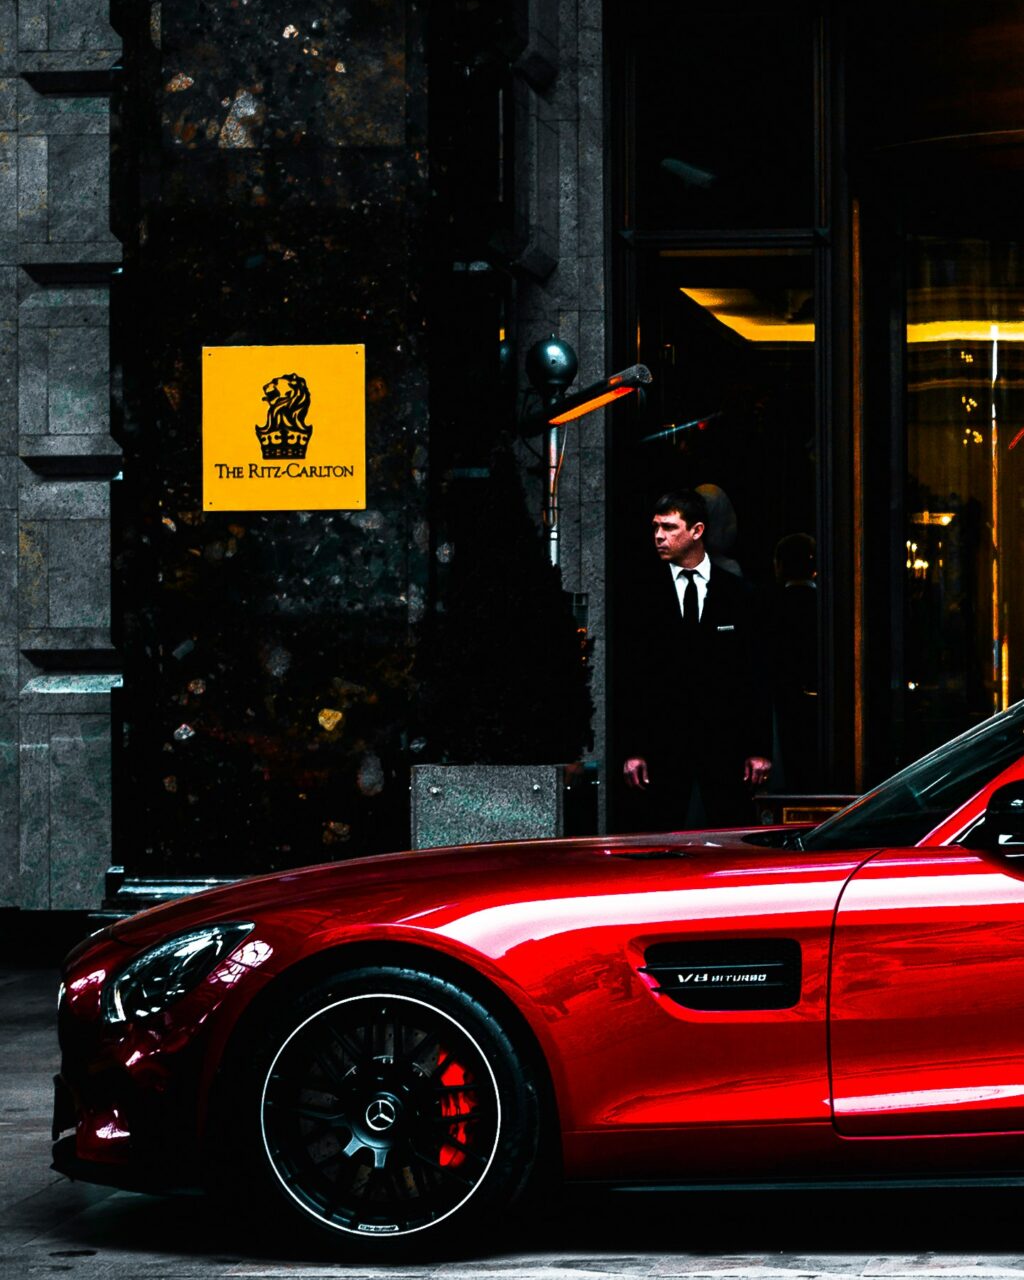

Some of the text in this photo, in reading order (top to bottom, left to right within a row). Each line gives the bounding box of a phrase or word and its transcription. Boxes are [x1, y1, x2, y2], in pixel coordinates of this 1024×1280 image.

[214, 463, 354, 479] THE RITZ-CARLTON
[677, 973, 709, 983] V8
